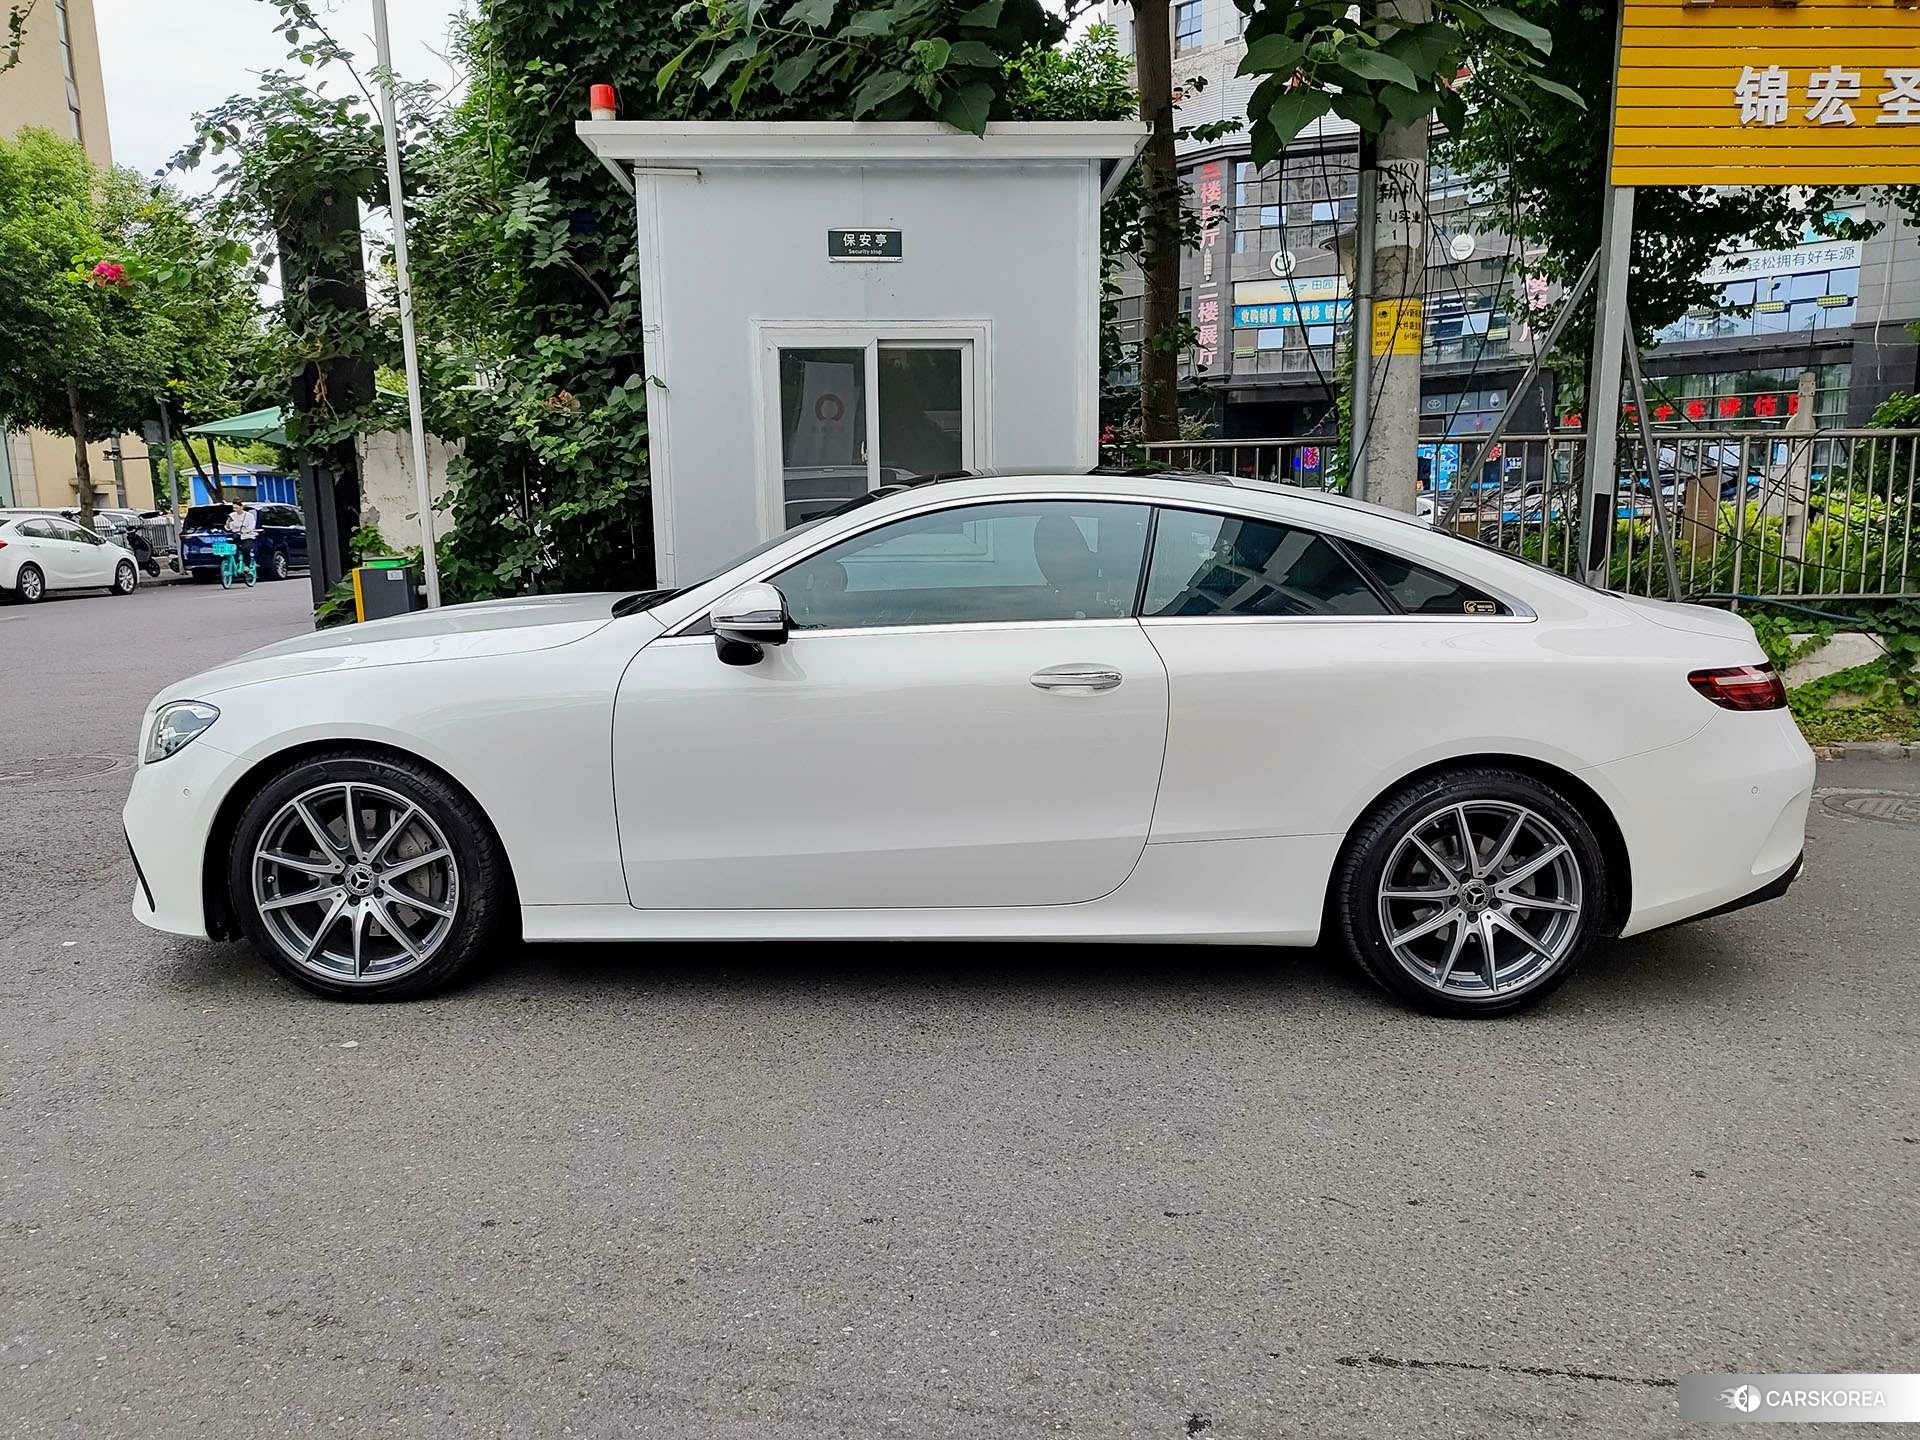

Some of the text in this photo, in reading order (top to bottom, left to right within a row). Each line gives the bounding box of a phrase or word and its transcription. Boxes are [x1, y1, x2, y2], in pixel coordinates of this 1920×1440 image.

[1734, 64, 1920, 126] 锦宏圣
[843, 232, 888, 247] 保安亭
[1198, 281, 1220, 367] 二楼展厅
